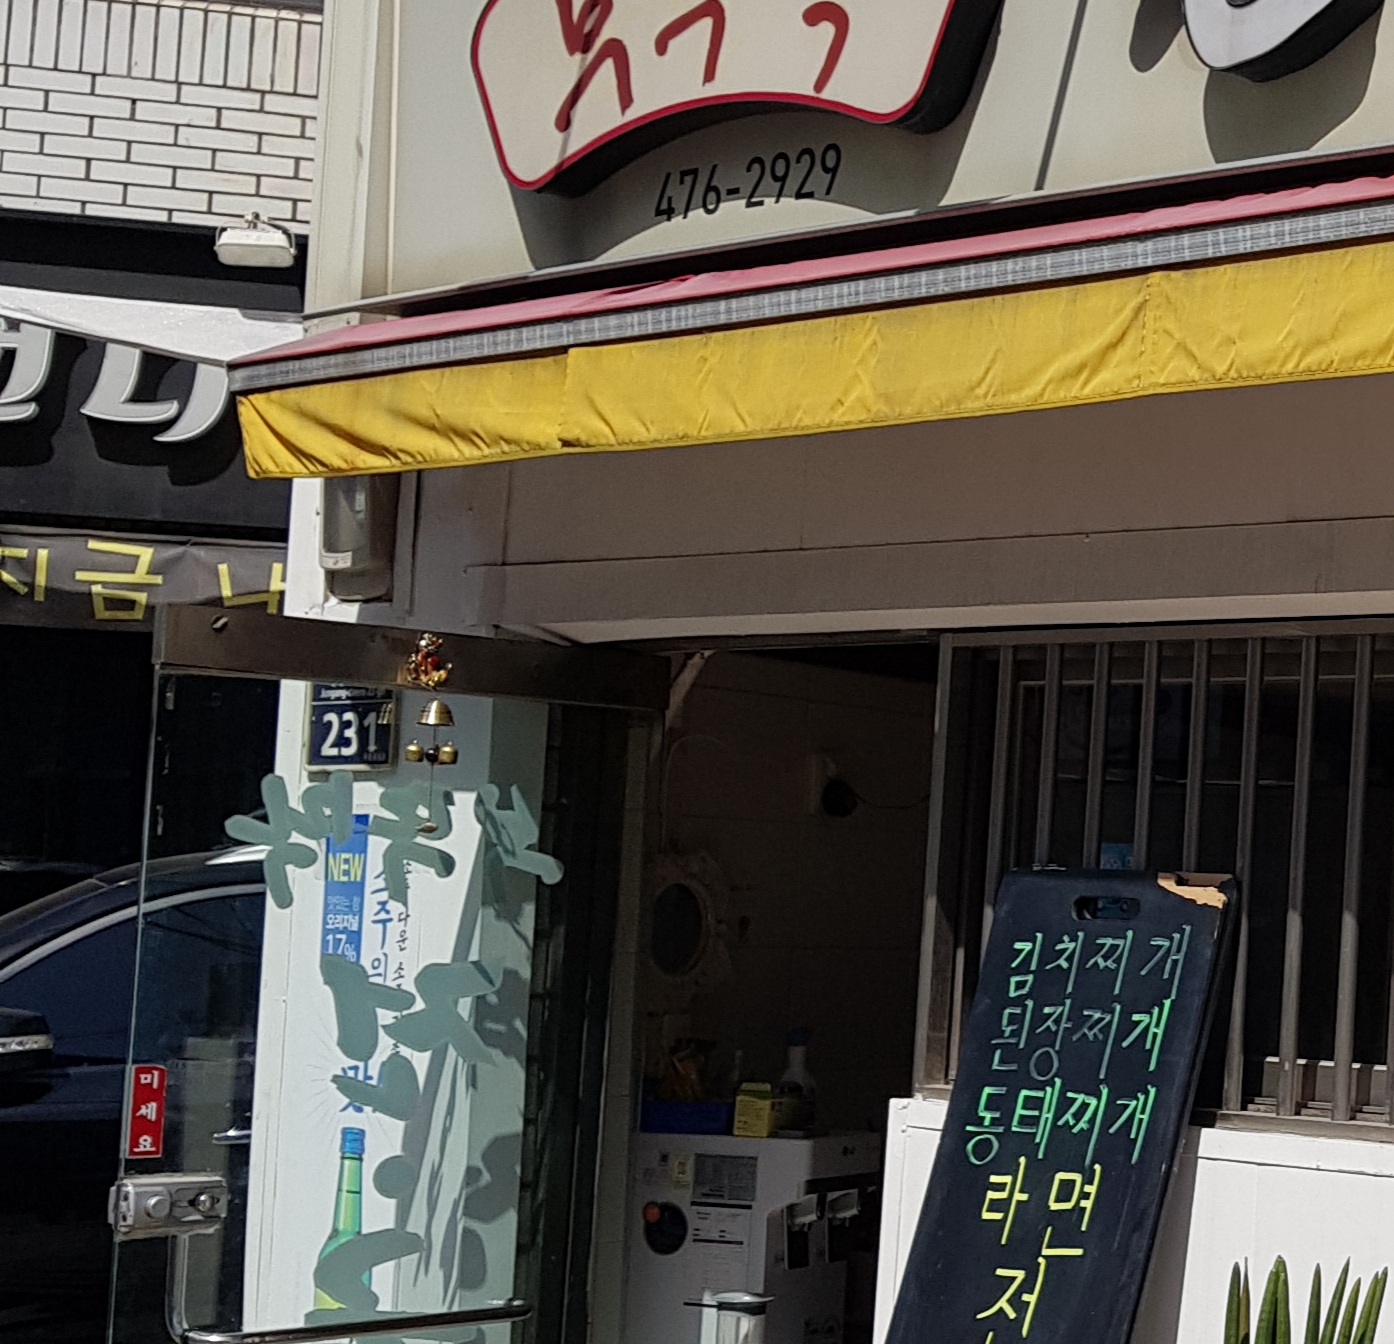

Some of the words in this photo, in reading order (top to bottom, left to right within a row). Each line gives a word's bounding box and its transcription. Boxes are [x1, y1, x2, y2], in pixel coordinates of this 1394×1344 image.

[653, 142, 843, 223] 476-2929
[320, 711, 378, 757] 231
[327, 852, 364, 883] NEW
[325, 914, 360, 932] 오리지널
[1008, 923, 1193, 1000] 김치찌개
[990, 997, 1173, 1082] 된장찌개
[133, 1069, 160, 1153] 미세요
[964, 1076, 1158, 1166] 동태찌개
[980, 1155, 1101, 1259] 라면
